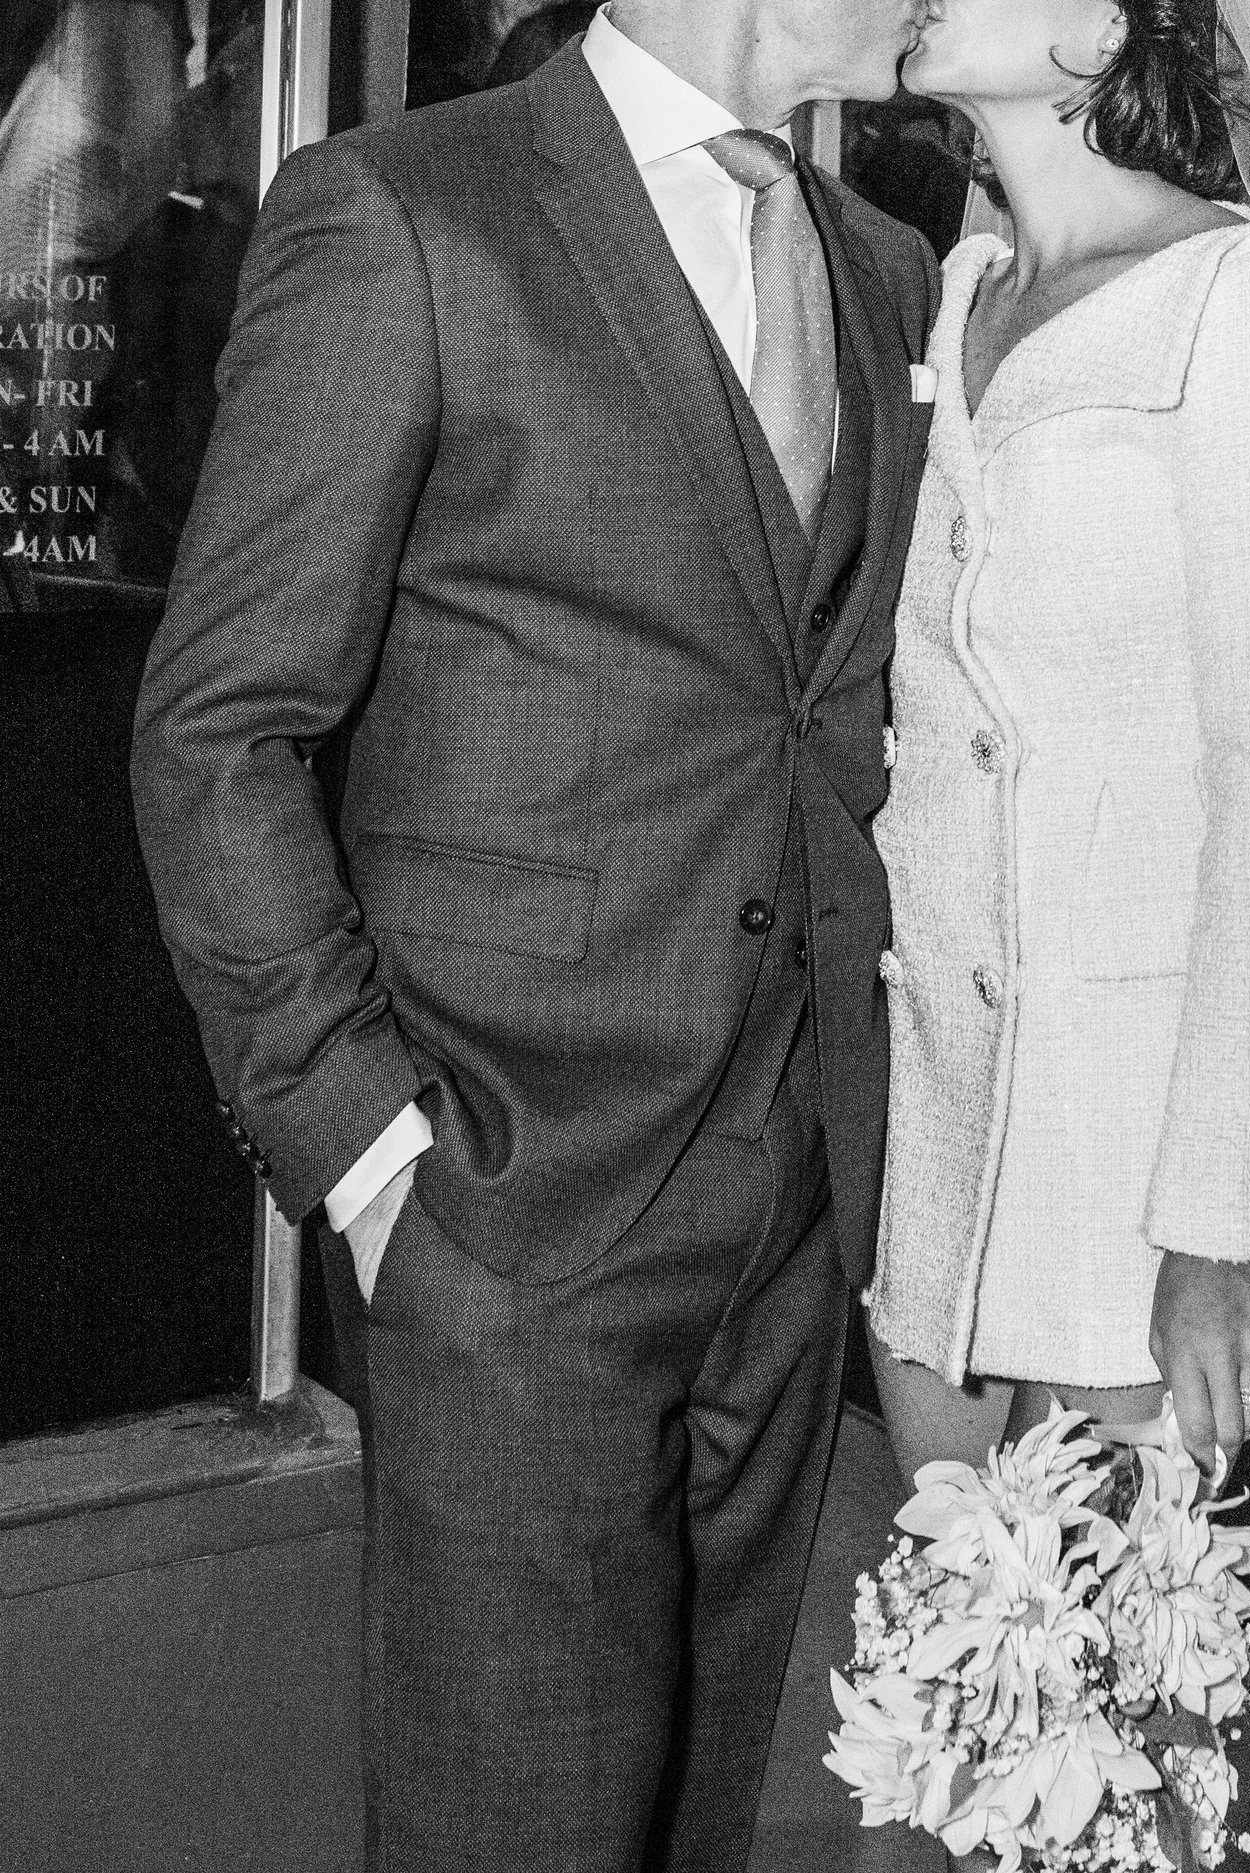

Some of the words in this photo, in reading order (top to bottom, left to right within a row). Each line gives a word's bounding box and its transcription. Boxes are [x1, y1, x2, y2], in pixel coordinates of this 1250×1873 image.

[5, 273, 50, 300] RS
[60, 274, 107, 302] OF
[0, 322, 116, 351] ATION
[36, 379, 93, 407] FRI
[29, 485, 97, 513] SUN
